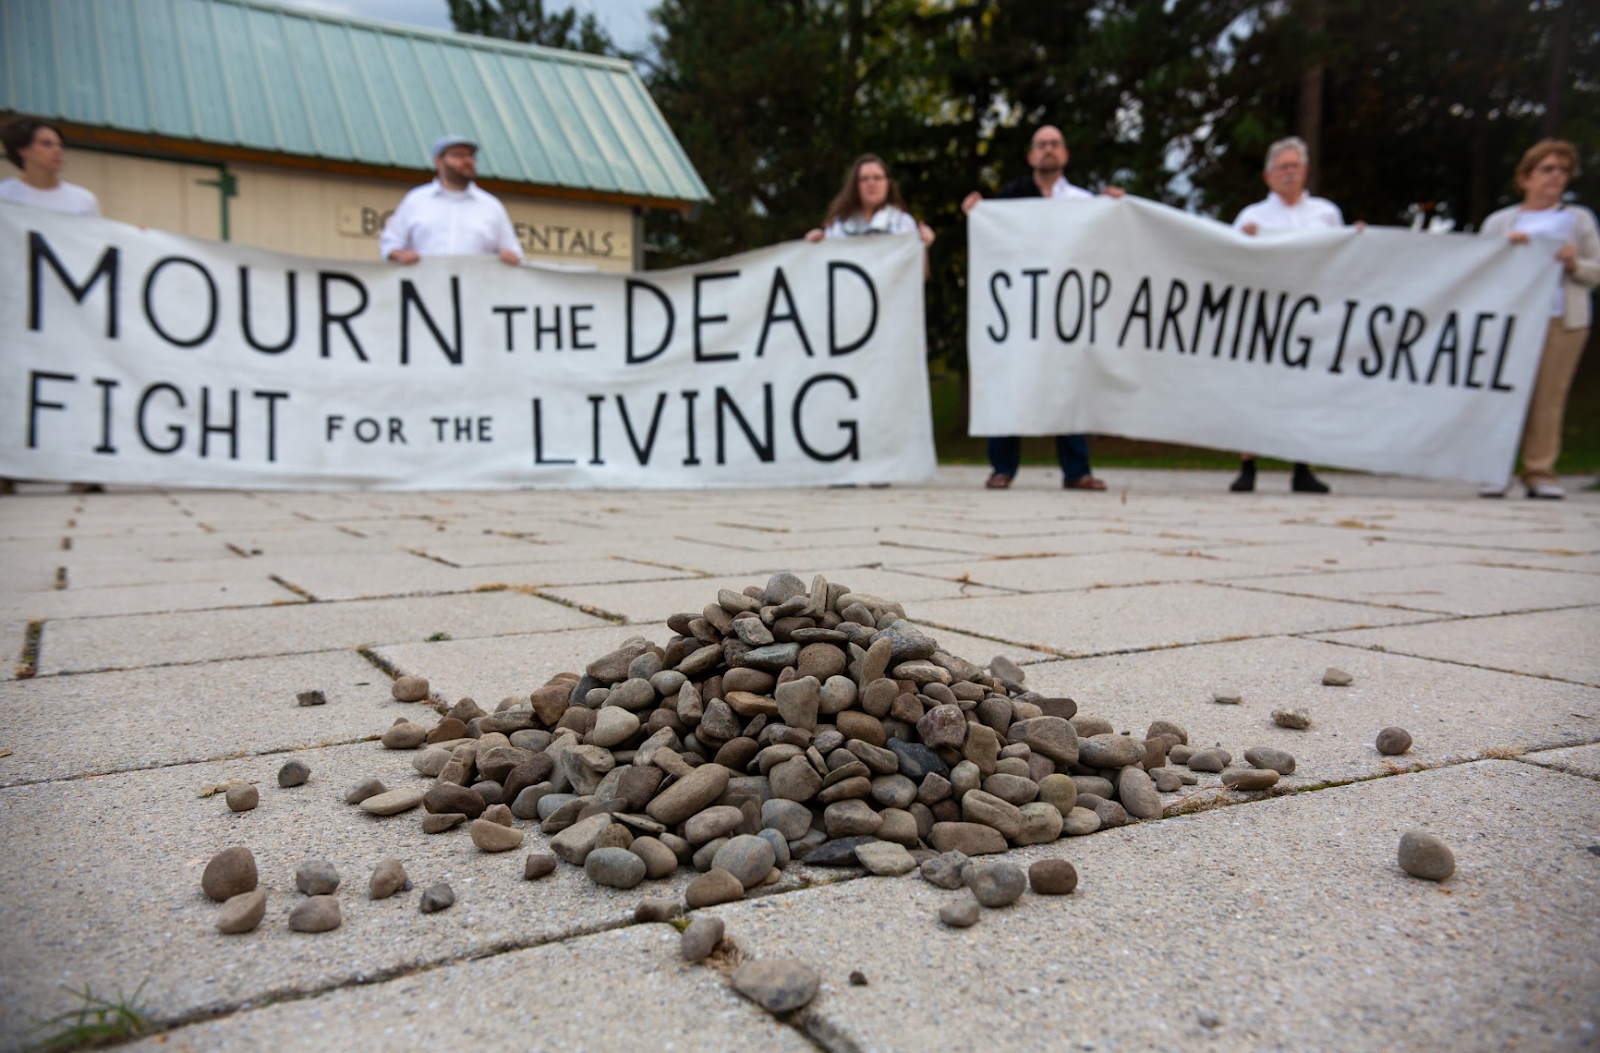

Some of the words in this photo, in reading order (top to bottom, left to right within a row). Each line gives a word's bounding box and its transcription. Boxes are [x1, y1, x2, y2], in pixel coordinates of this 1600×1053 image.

[513, 221, 614, 257] ENTALS
[27, 230, 464, 366] MOURN
[492, 304, 597, 353] THE
[624, 261, 879, 365] DEAD
[987, 268, 1111, 345] STOP
[1118, 276, 1321, 370] ARMING
[1328, 299, 1516, 392] ISRAEL
[26, 370, 290, 463] FIGHT
[326, 415, 407, 443] FOR
[431, 416, 493, 442] THE
[532, 373, 860, 466] LIVING
